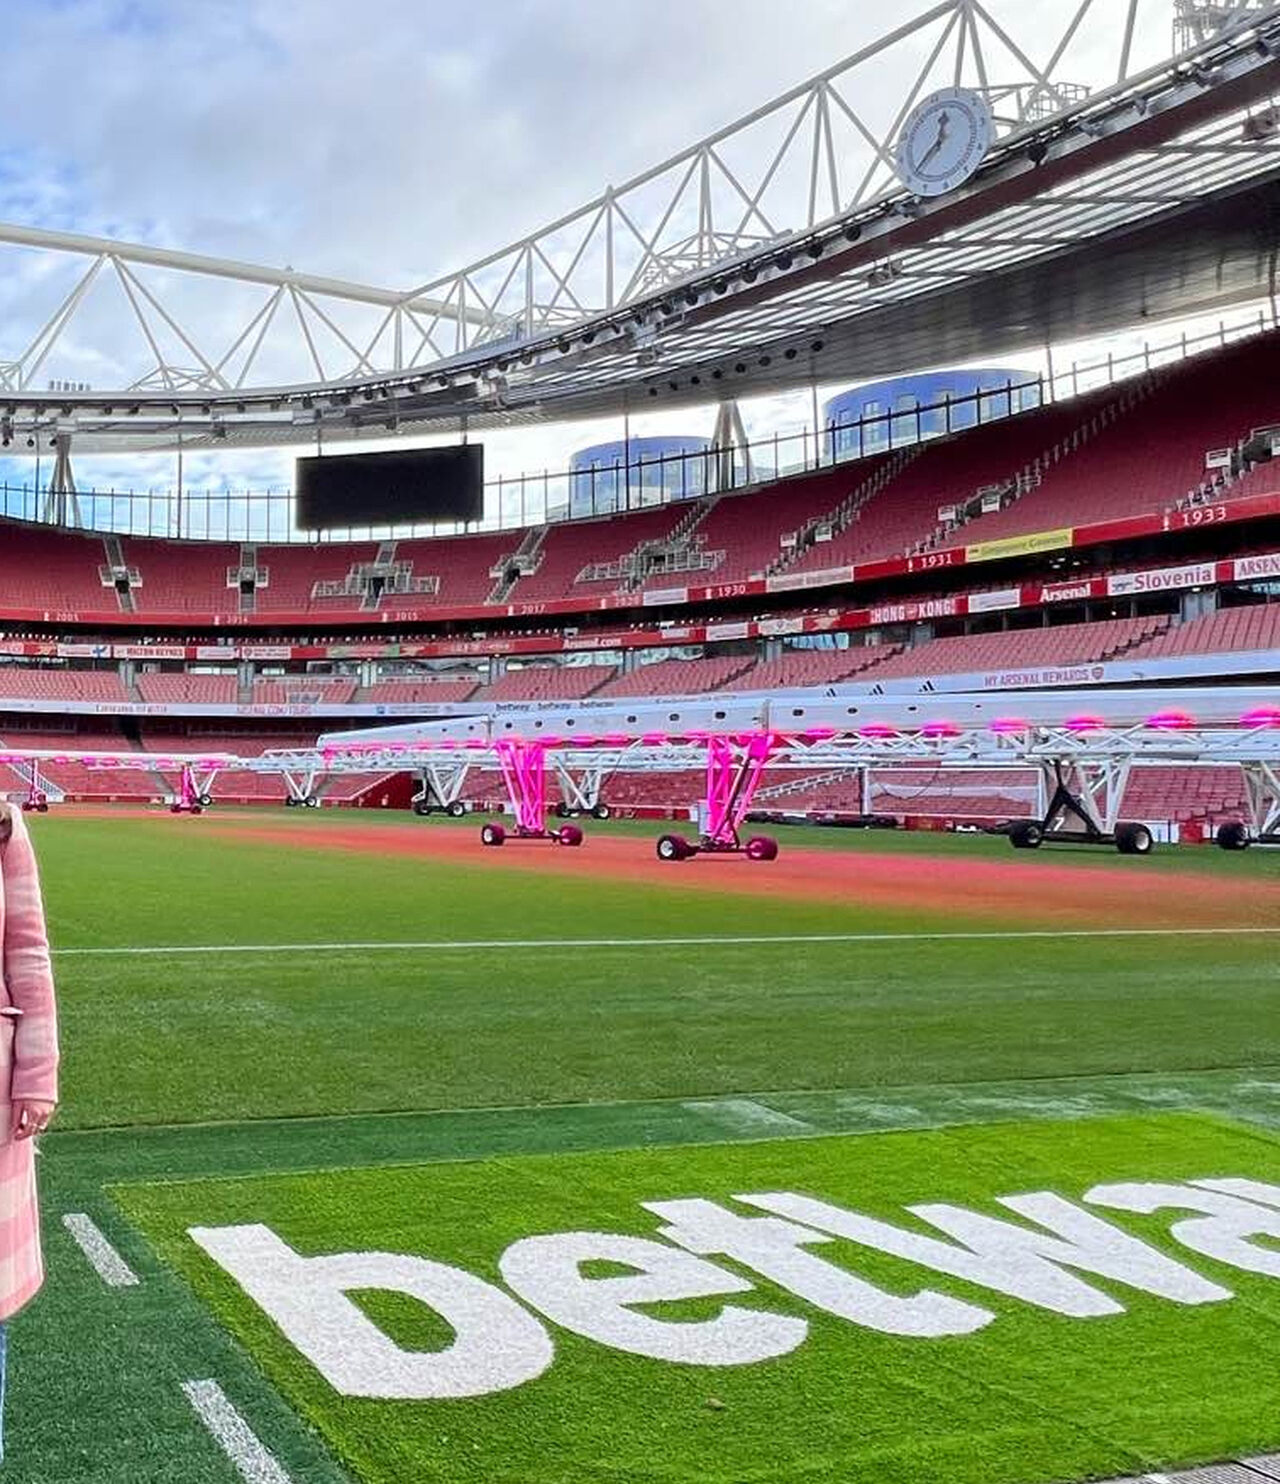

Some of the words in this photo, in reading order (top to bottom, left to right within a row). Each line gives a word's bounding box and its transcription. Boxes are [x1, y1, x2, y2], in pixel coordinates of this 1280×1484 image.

[1182, 507, 1227, 527] 1933
[921, 553, 952, 569] 1931
[1134, 565, 1213, 591] Slovenia
[718, 584, 746, 598] 1930
[1039, 583, 1091, 603] Arsenal
[187, 1178, 1280, 1399] betwa
